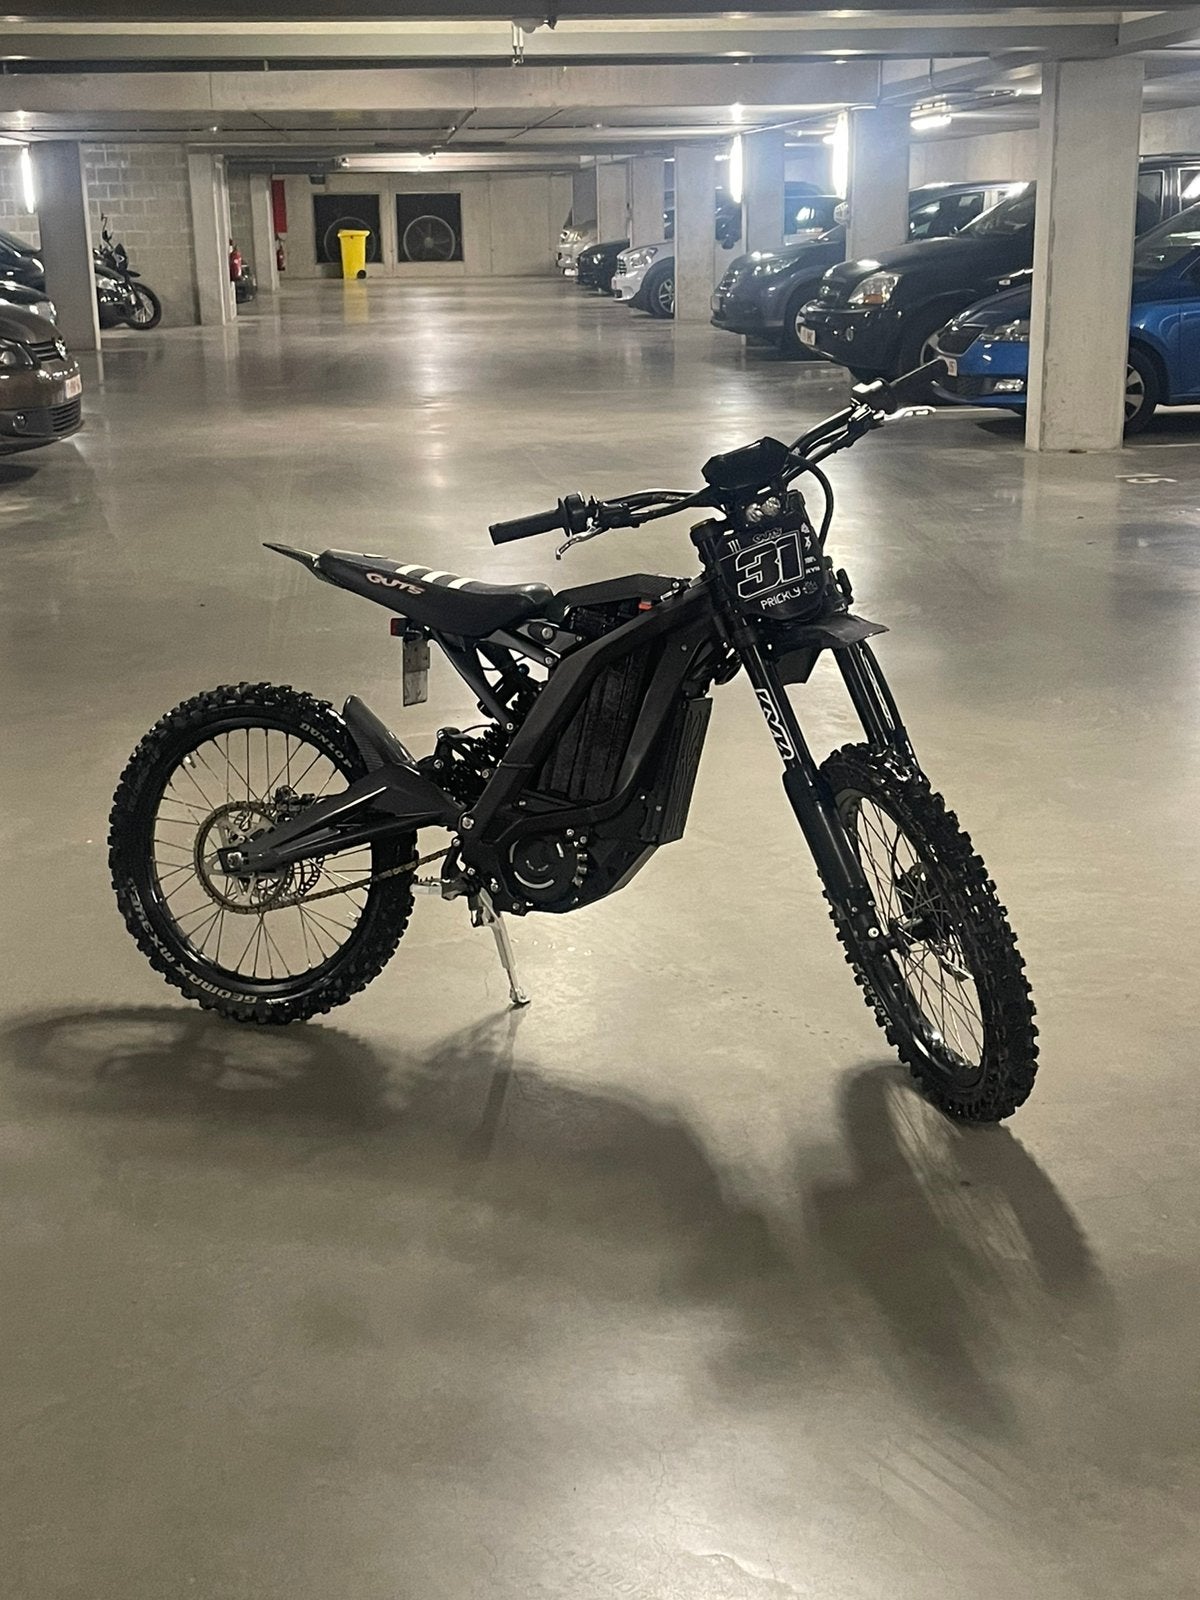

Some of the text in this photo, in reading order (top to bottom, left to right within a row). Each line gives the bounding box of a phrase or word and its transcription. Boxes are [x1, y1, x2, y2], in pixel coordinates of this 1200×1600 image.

[366, 572, 426, 595] GUTS
[735, 532, 803, 599] 31
[760, 586, 801, 610] PRICKLY
[299, 722, 353, 768] DUNLOP
[175, 963, 257, 1004] GEOMAX
[855, 962, 893, 1027] DUNLOP
